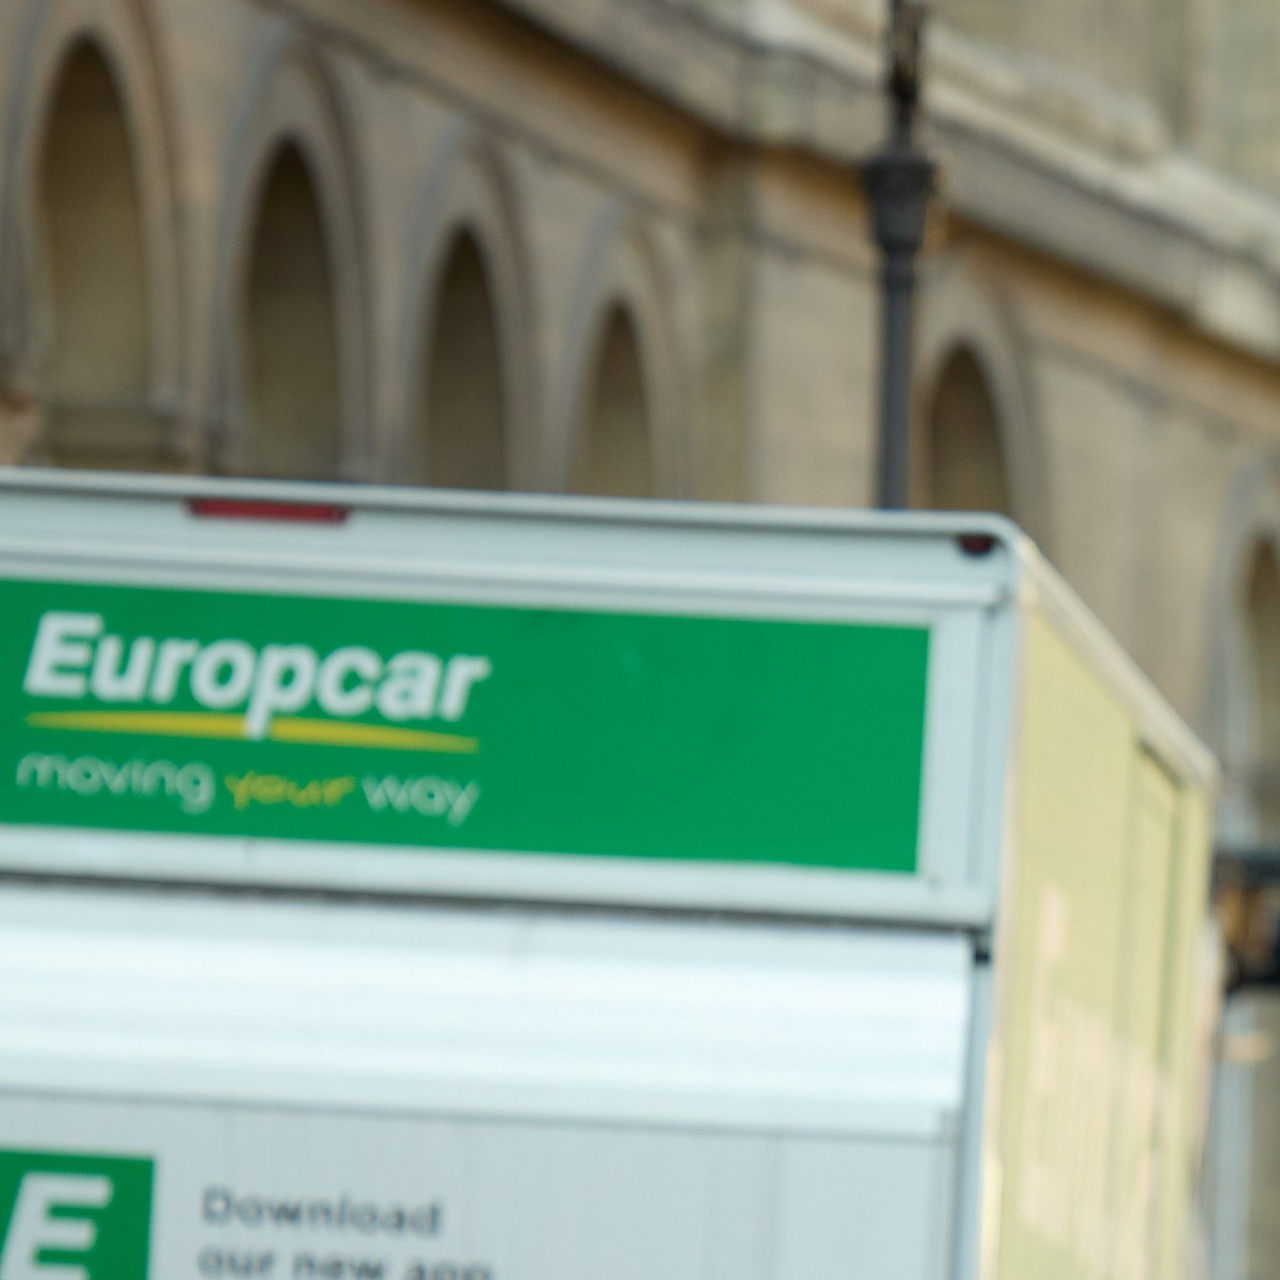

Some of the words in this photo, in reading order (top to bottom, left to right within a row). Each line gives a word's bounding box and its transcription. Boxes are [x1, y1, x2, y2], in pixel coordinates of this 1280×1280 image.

[22, 609, 492, 740] Europcar
[16, 752, 216, 814] moving
[225, 770, 356, 811] your
[361, 773, 482, 826] way
[201, 1184, 446, 1236] Download
